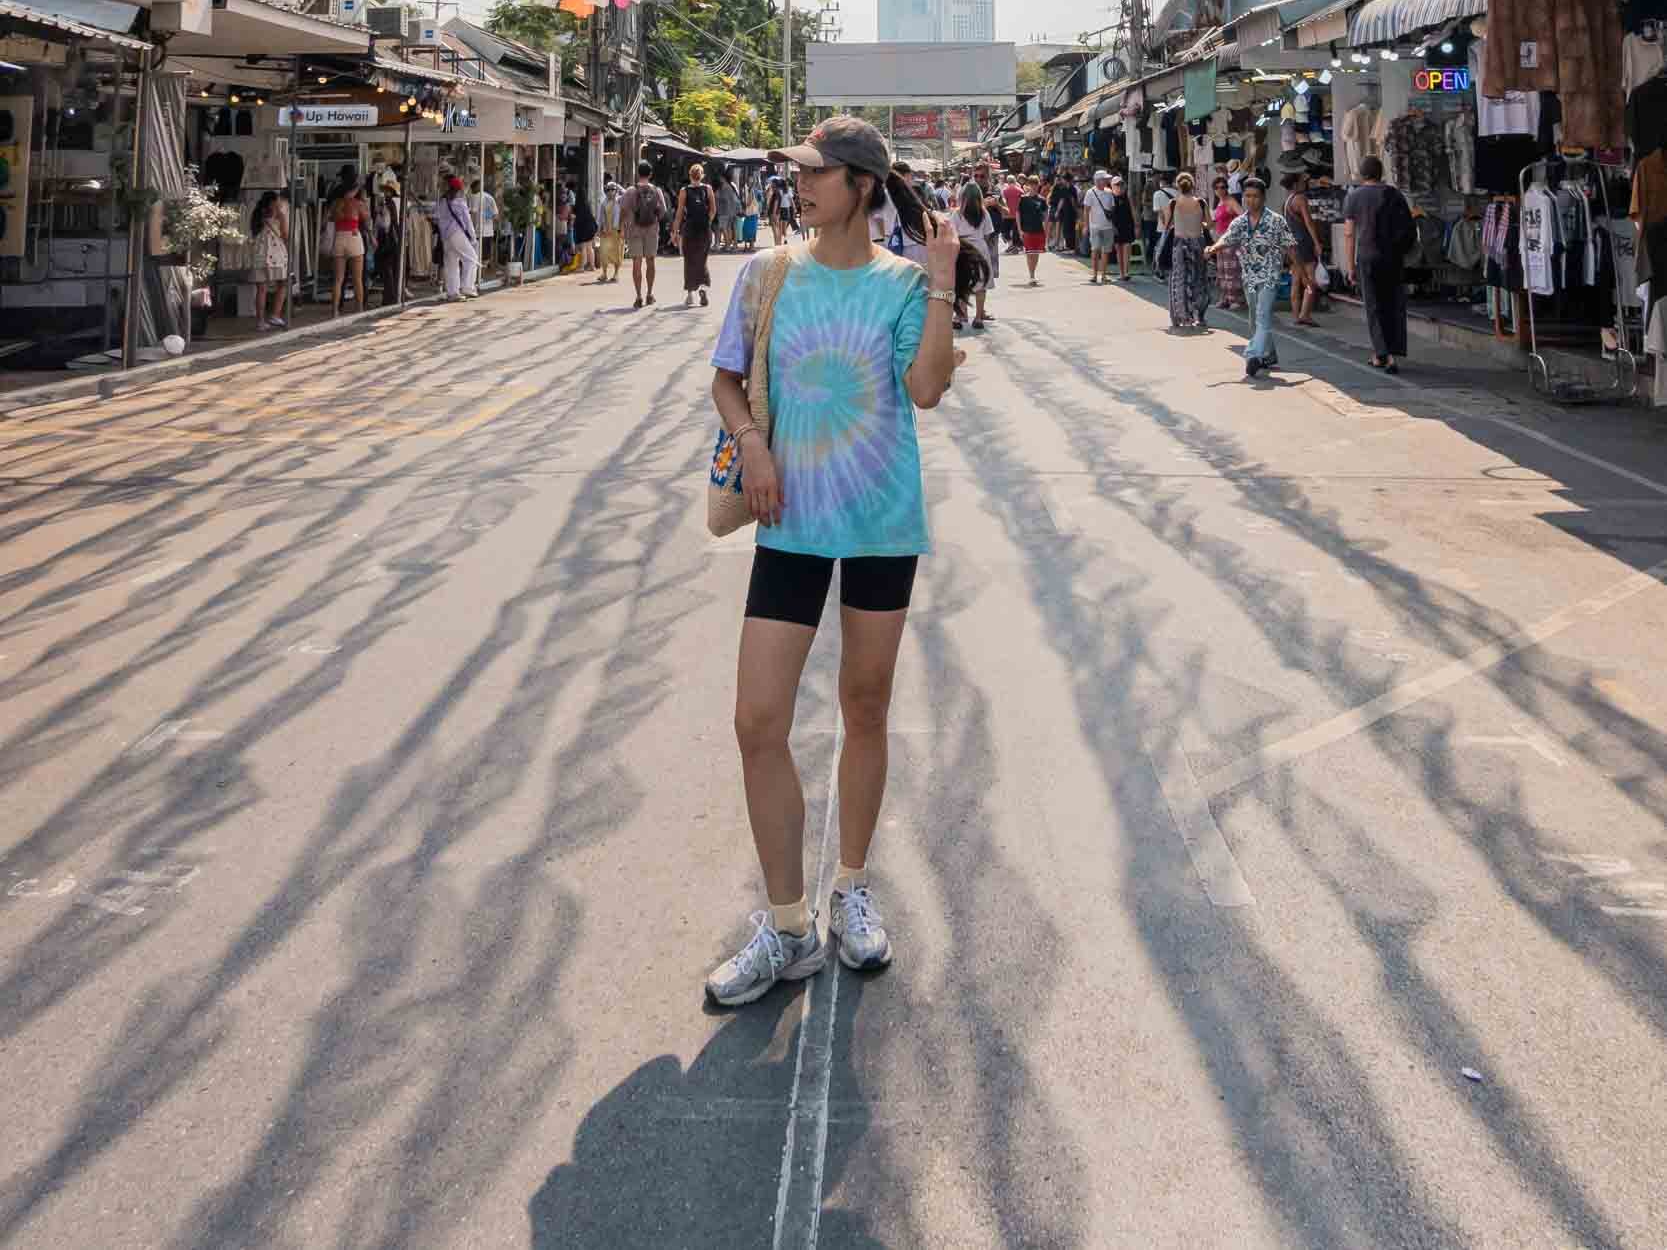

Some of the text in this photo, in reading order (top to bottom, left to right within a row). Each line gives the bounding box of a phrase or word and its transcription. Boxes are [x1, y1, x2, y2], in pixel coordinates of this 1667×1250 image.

[1415, 71, 1469, 90] OPEN
[305, 110, 369, 123] Up Hawaii
